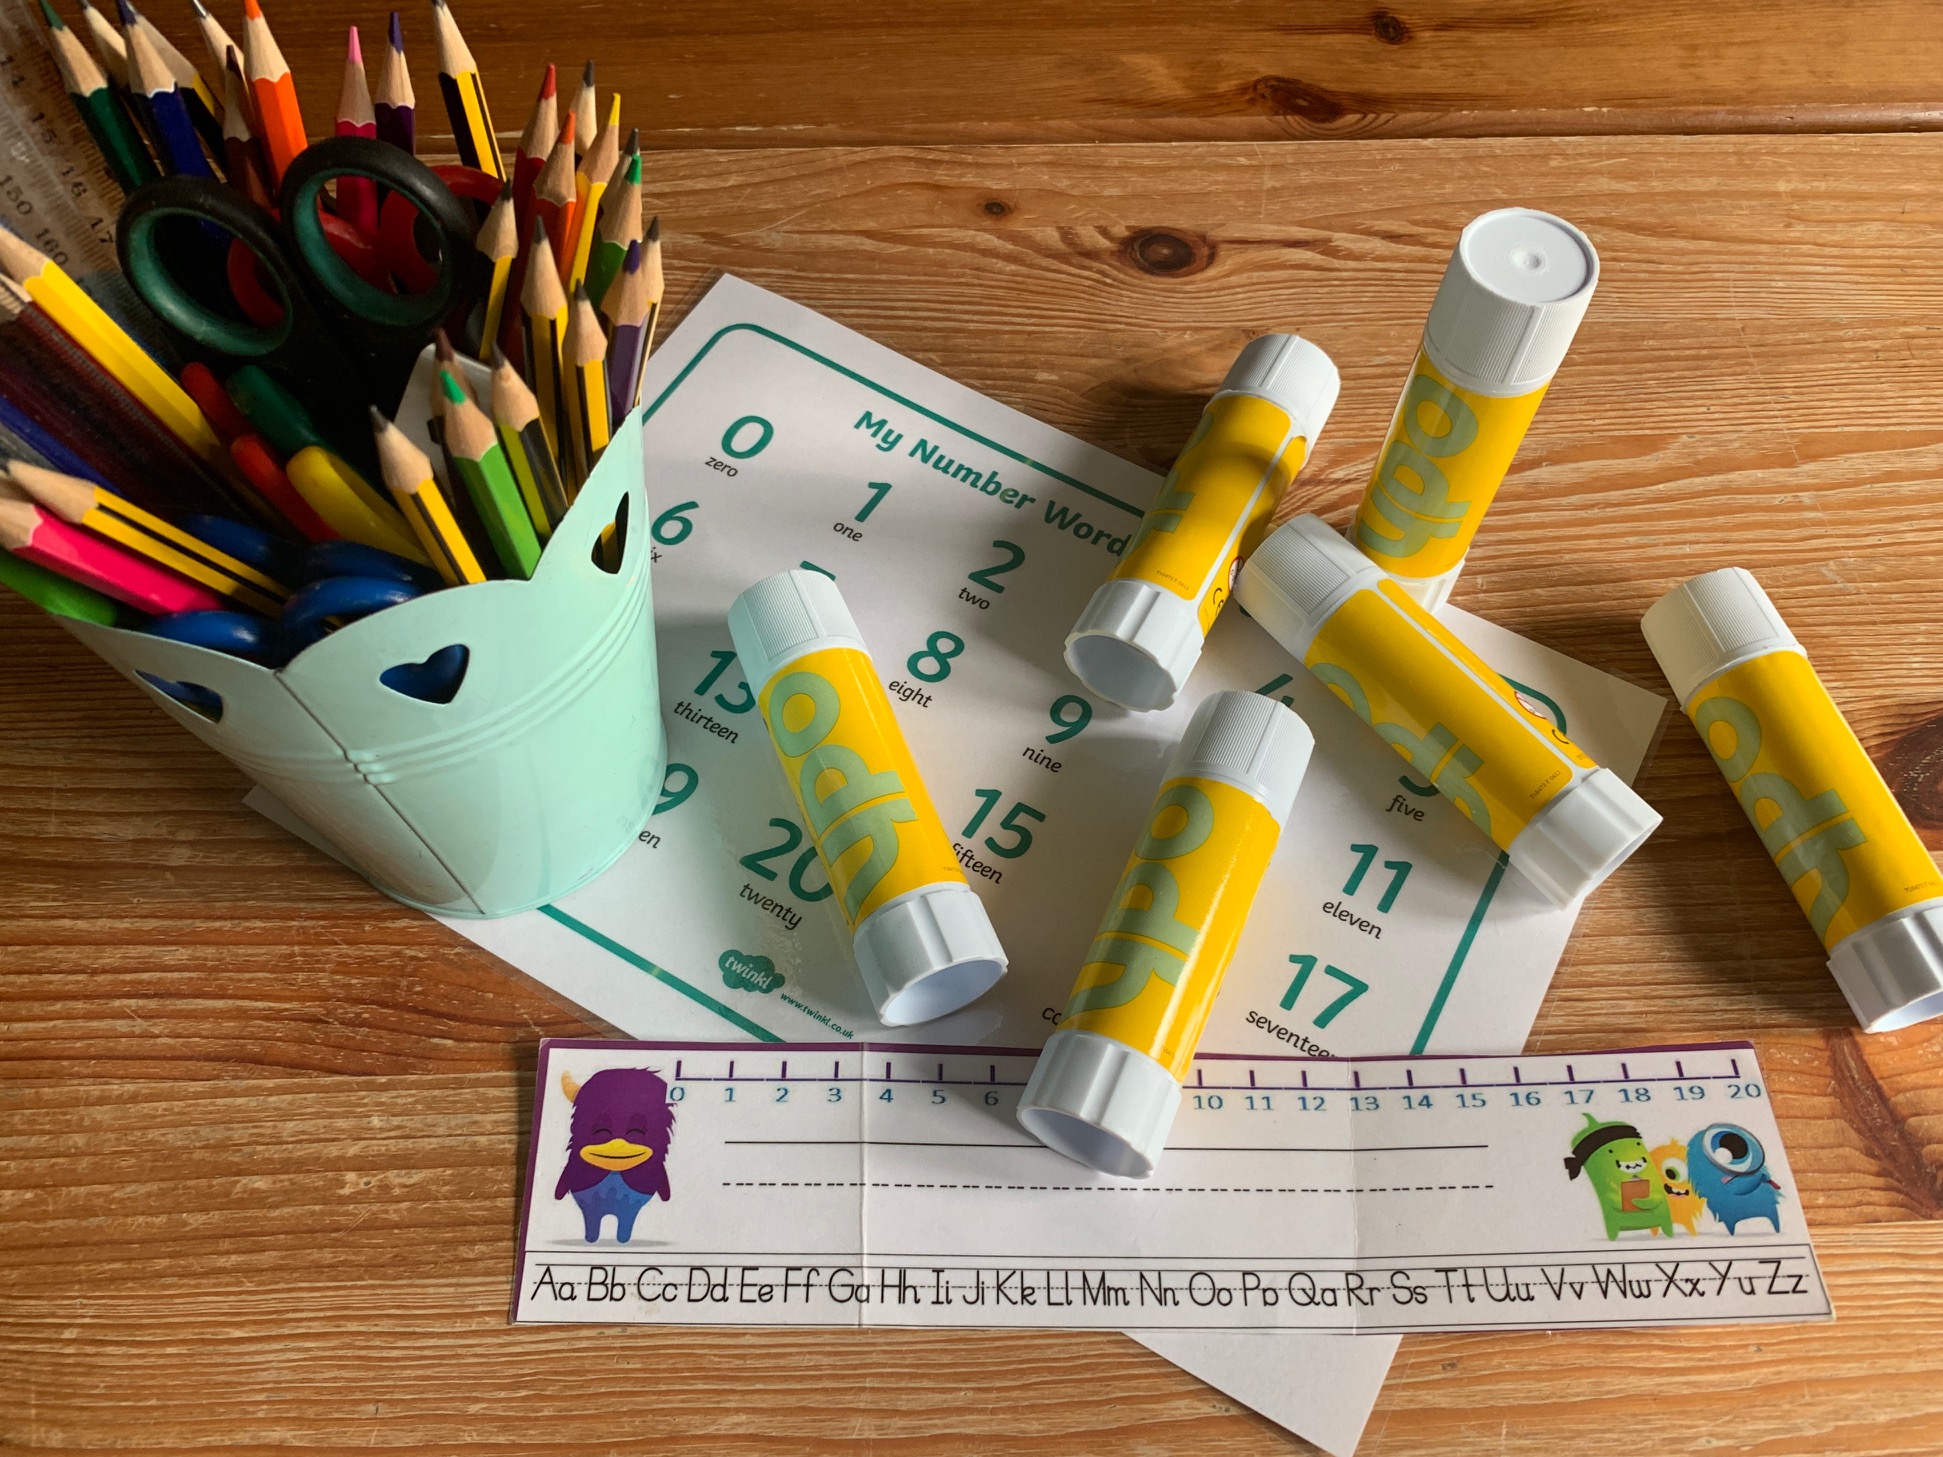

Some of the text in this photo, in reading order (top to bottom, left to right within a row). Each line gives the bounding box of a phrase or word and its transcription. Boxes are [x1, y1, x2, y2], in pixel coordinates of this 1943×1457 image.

[61, 165, 88, 198] 16
[35, 227, 69, 267] 160
[89, 216, 115, 245] 17
[721, 415, 775, 460] 0
[705, 456, 739, 479] zero
[854, 410, 904, 453] My
[908, 438, 1036, 510] Number
[651, 500, 700, 546] 6
[854, 481, 893, 524] 1
[833, 521, 864, 543] one
[967, 539, 1026, 595] 2
[958, 586, 991, 611] two
[906, 630, 966, 683] 8
[888, 680, 934, 709] eight
[673, 700, 740, 744] thirteen
[1045, 694, 1093, 745] 9
[1022, 745, 1063, 774] nine
[961, 788, 1047, 859] 15
[1385, 794, 1426, 822] five
[739, 817, 835, 903] 20
[1342, 843, 1414, 914] 11
[739, 882, 804, 931] twenty
[1322, 900, 1383, 940] eleven
[724, 954, 774, 991] twinkl
[1279, 953, 1369, 1030] 17
[780, 992, 855, 1040] www.twinkl.co.uk
[1245, 1009, 1337, 1058] seventee
[668, 1082, 1763, 1112] 0 1 2 3 4 5 6 10 11 12 13 14 15 16 17 18 19 20
[531, 1266, 577, 1302] Aa
[586, 1267, 626, 1303] Bb
[637, 1267, 678, 1303] Cc
[687, 1268, 729, 1304] Dd
[739, 1267, 774, 1304] Ee
[784, 1268, 820, 1304] Ff
[880, 1269, 921, 1305] Hh
[931, 1269, 953, 1305] Ii
[996, 1270, 1036, 1307] Kk
[1046, 1270, 1073, 1307] Ll
[1082, 1270, 1130, 1307] Mm
[1140, 1271, 1179, 1308] Nn
[1188, 1272, 1233, 1308] Oo
[1345, 1272, 1381, 1308] Rr
[1390, 1270, 1428, 1306] Ss
[1434, 1268, 1475, 1304] Tt
[1483, 1267, 1535, 1303] Uu
[1541, 1266, 1585, 1301] Vv
[1592, 1264, 1652, 1300] Ww
[1655, 1262, 1706, 1299] Xx
[1758, 1260, 1808, 1296] Zz
